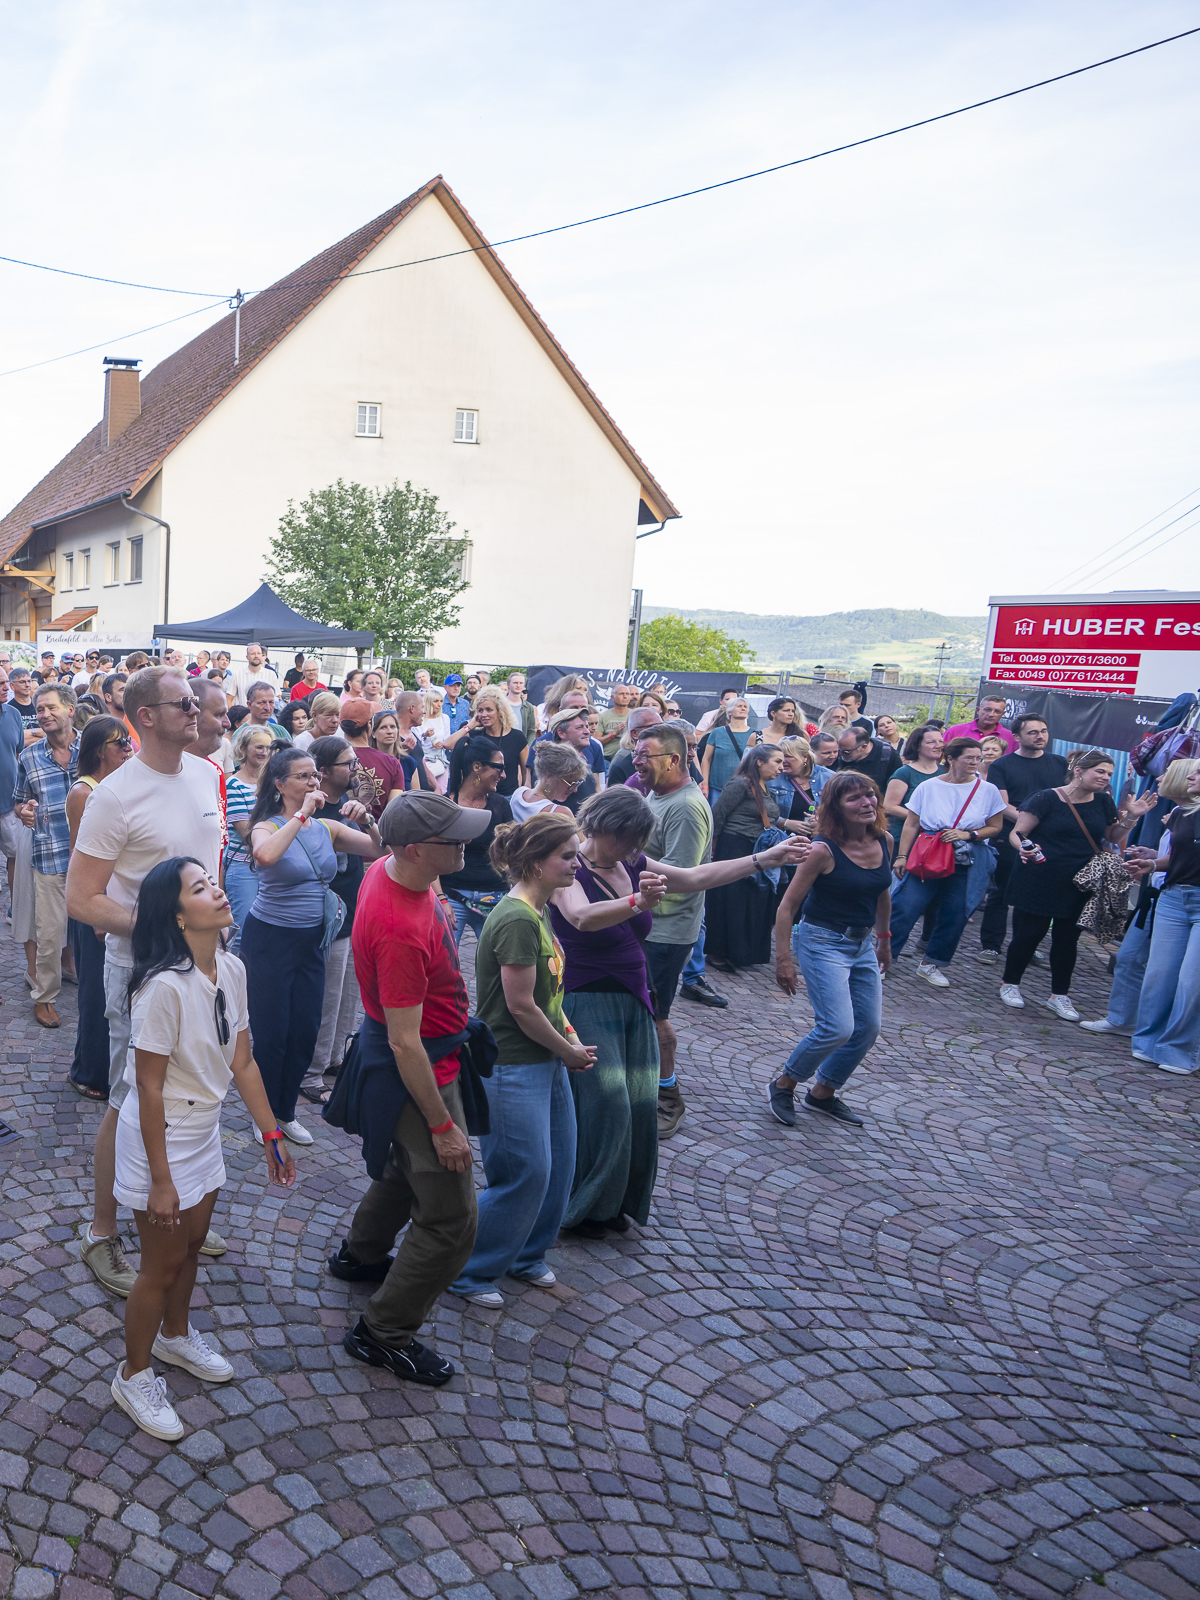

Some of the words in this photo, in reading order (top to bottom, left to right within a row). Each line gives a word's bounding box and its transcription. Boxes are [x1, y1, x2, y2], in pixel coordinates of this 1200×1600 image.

[1042, 618, 1146, 636] HUBER
[45, 634, 81, 644] Breitenfeld
[998, 653, 1016, 663] Tel.
[1019, 654, 1047, 663] 0049
[1049, 655, 1128, 666] (0)7761/3600
[996, 669, 1016, 678] Fax
[1018, 670, 1046, 679] 0049
[1048, 671, 1126, 682] (0)7761/3444
[606, 668, 682, 701] NARCOTIK
